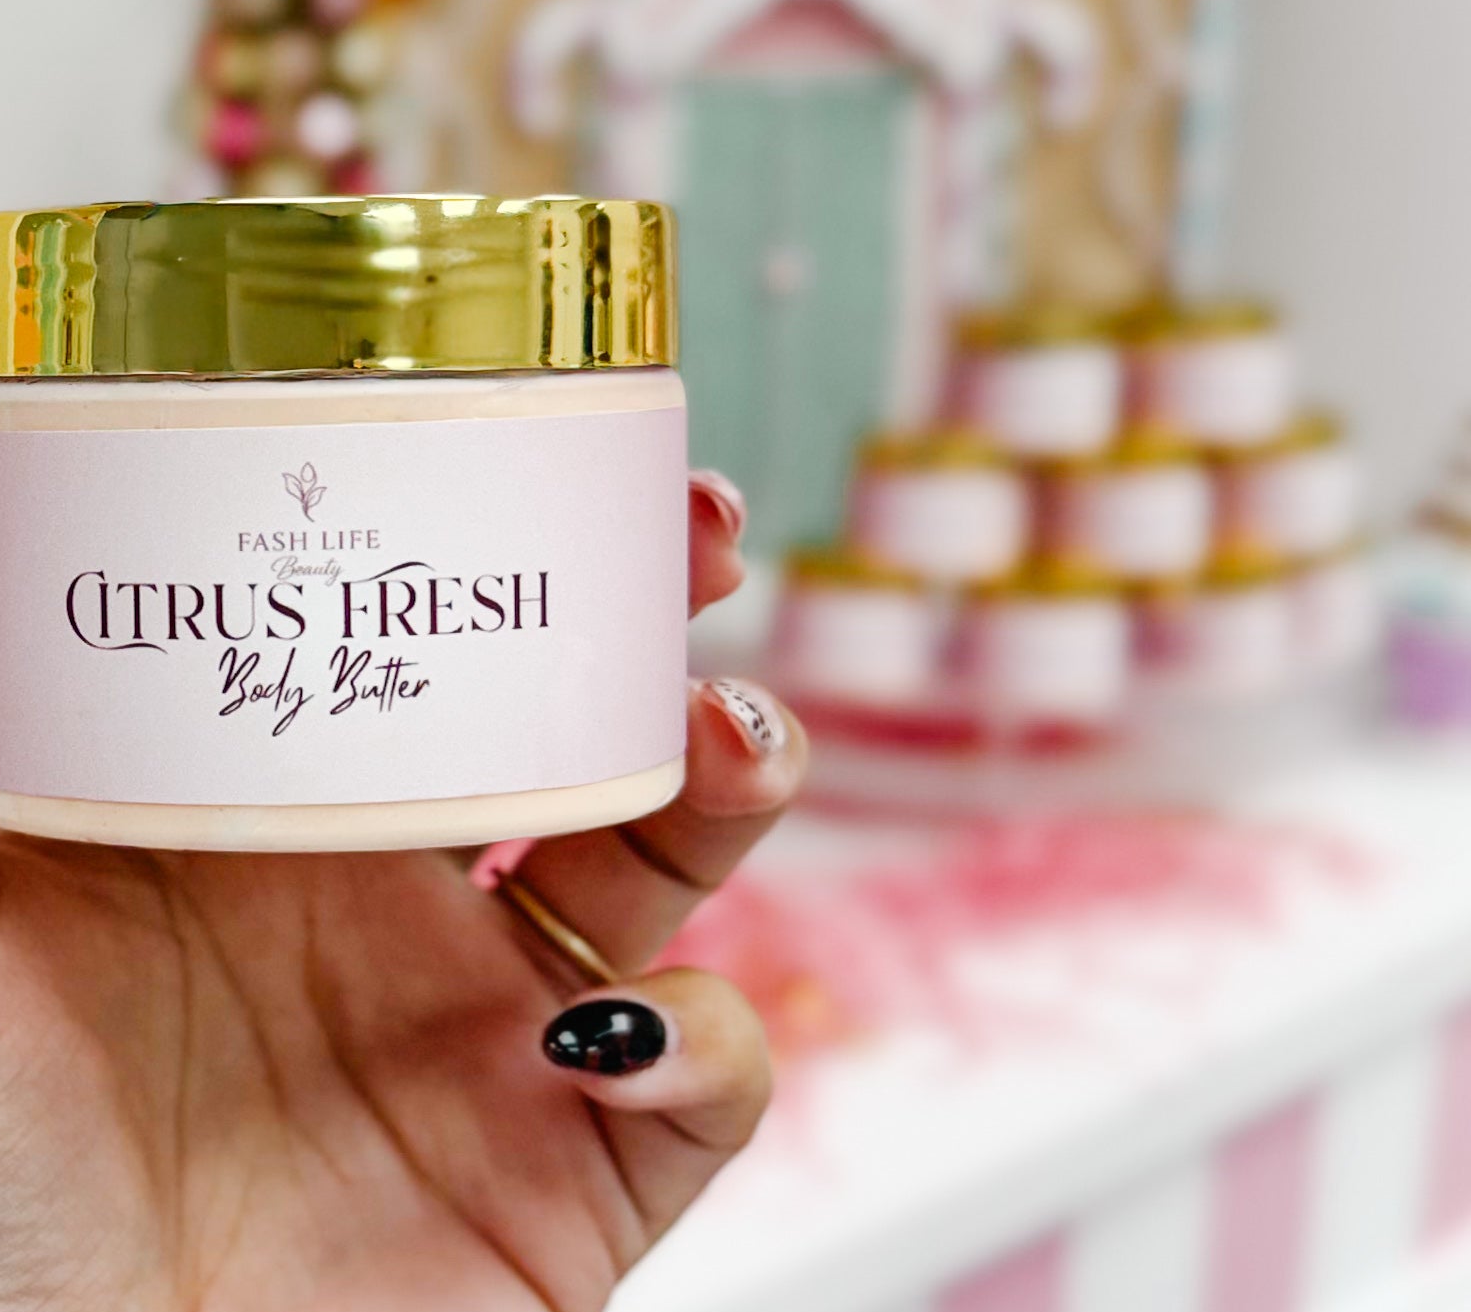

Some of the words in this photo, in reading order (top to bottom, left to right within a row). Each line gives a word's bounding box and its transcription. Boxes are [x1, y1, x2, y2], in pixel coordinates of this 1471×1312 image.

[237, 530, 308, 553] FASH
[321, 528, 382, 551] LIFE
[269, 555, 346, 587] Beauty
[65, 569, 307, 655] CITRUS
[340, 560, 551, 639] FRESH
[218, 645, 316, 738] Body
[328, 644, 432, 716] Butter
